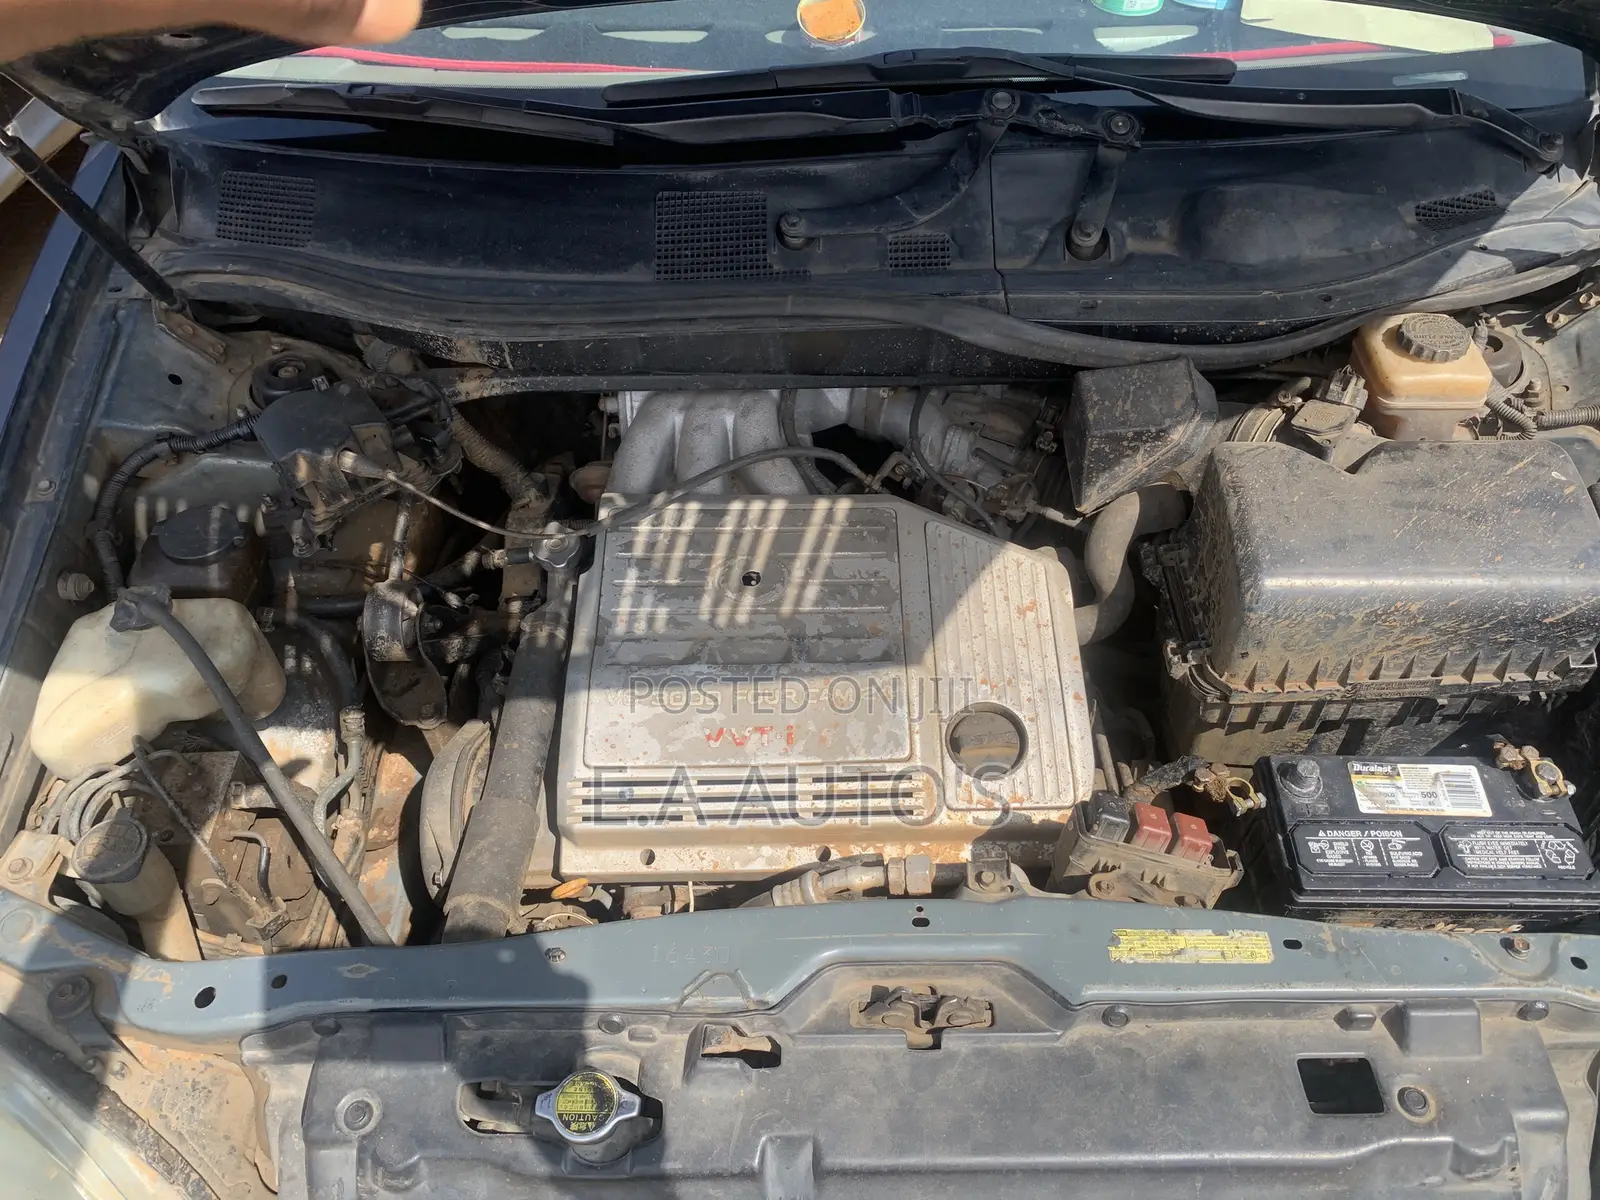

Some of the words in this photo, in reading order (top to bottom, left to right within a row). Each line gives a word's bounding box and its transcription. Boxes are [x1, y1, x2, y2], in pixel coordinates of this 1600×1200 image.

[1353, 763, 1393, 773] Duralast
[1421, 791, 1438, 799] 500
[1327, 830, 1363, 838] DANGER
[1370, 830, 1403, 838] POISON
[563, 1113, 605, 1122] CAUTION
